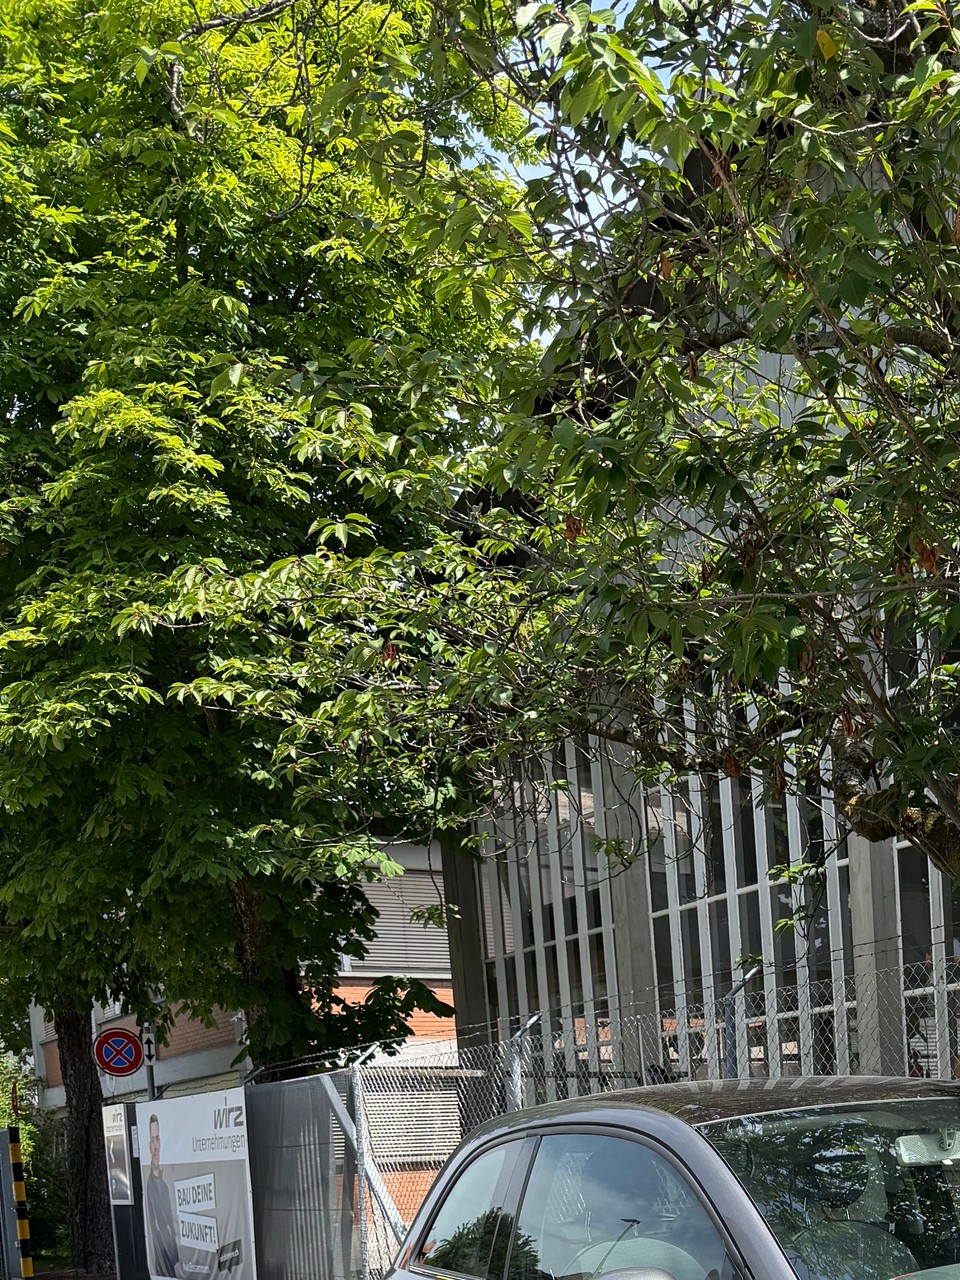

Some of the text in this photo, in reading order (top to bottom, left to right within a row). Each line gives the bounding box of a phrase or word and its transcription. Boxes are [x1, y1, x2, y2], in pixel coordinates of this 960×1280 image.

[213, 1096, 244, 1130] wirz
[191, 1133, 246, 1153] Unternehmungen
[177, 1183, 213, 1206] BAU DEINE
[180, 1220, 217, 1245] ZUKUNFT!
